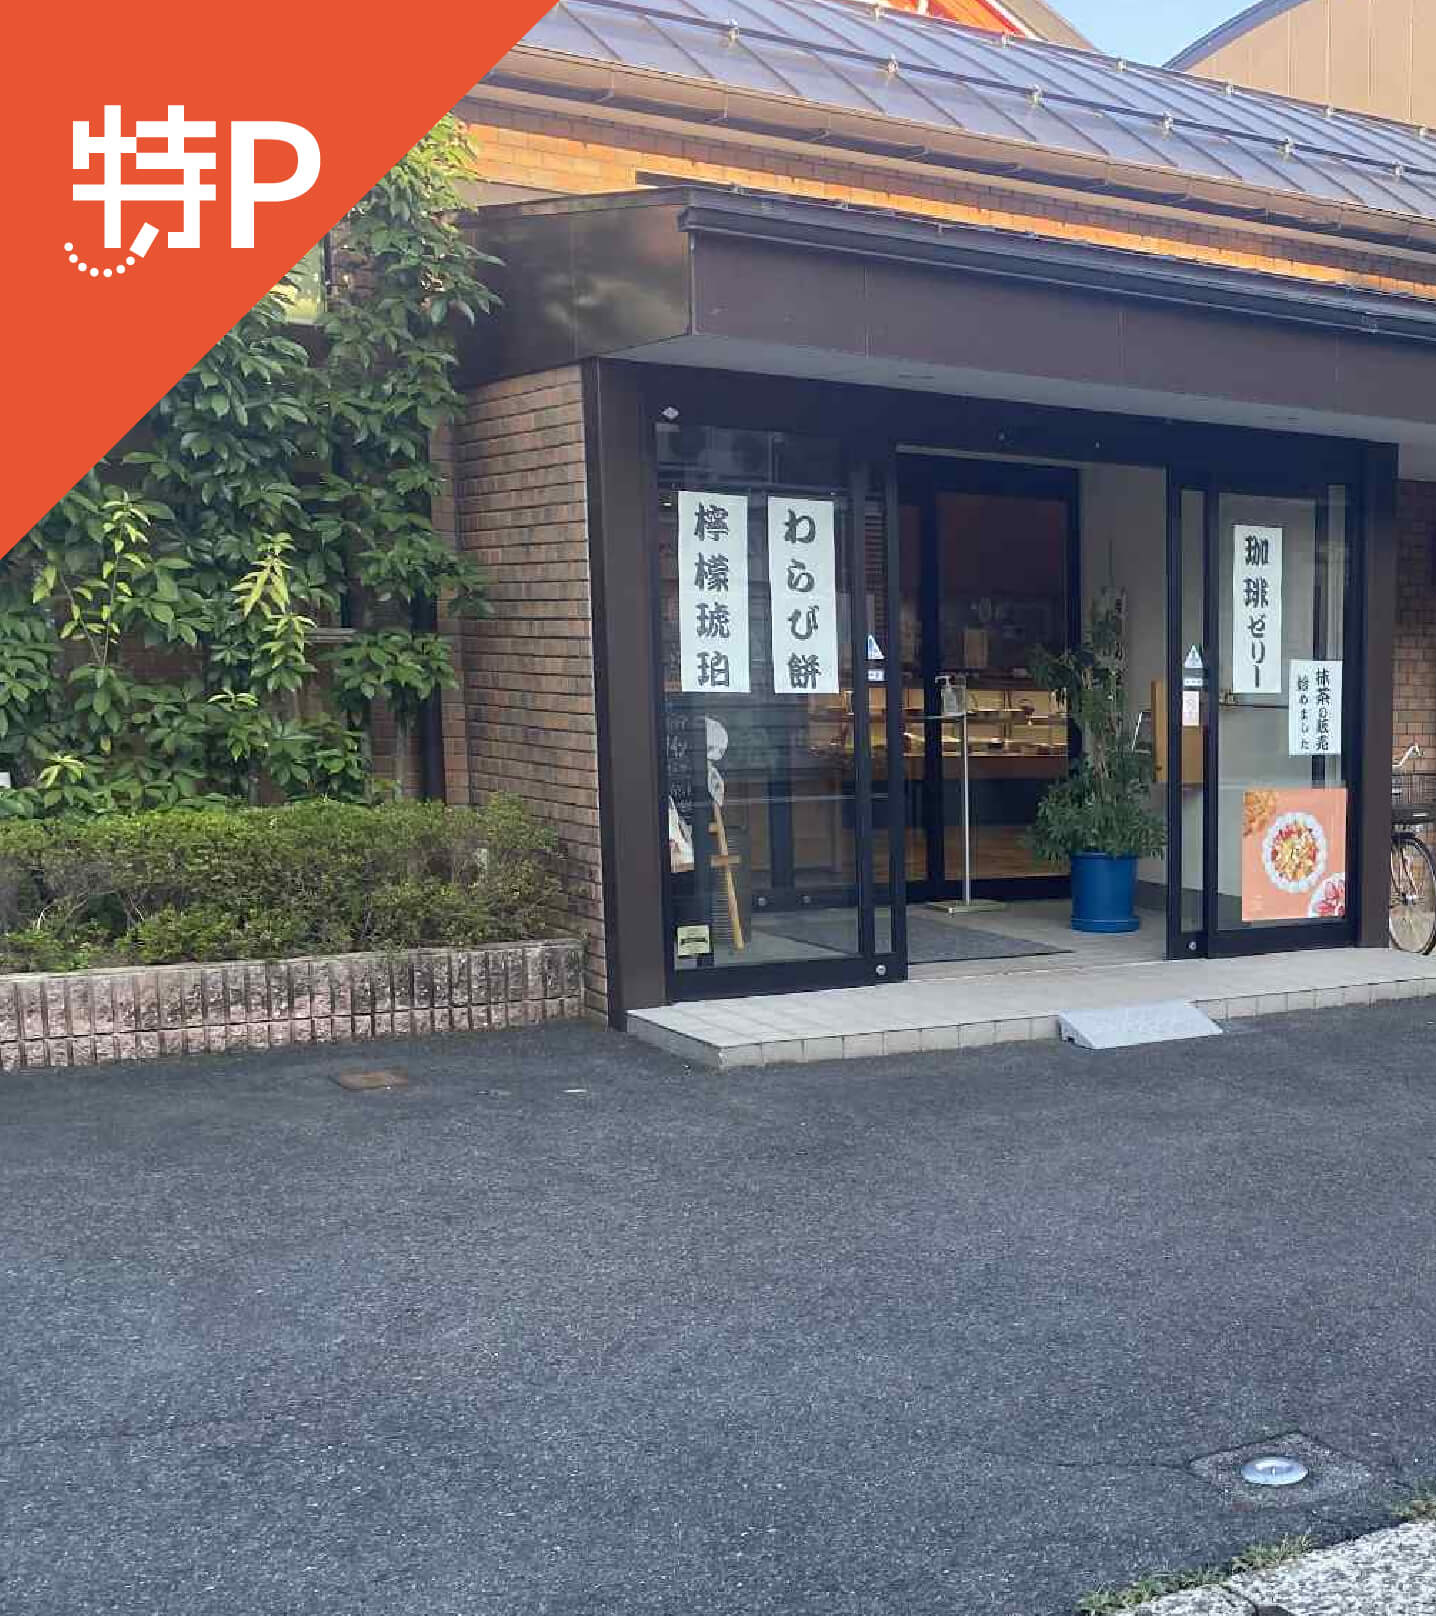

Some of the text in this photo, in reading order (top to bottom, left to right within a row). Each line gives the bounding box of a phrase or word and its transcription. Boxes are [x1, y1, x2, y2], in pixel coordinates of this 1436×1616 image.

[694, 502, 730, 687] 檸檬琥珀
[784, 507, 822, 690] わらび餅
